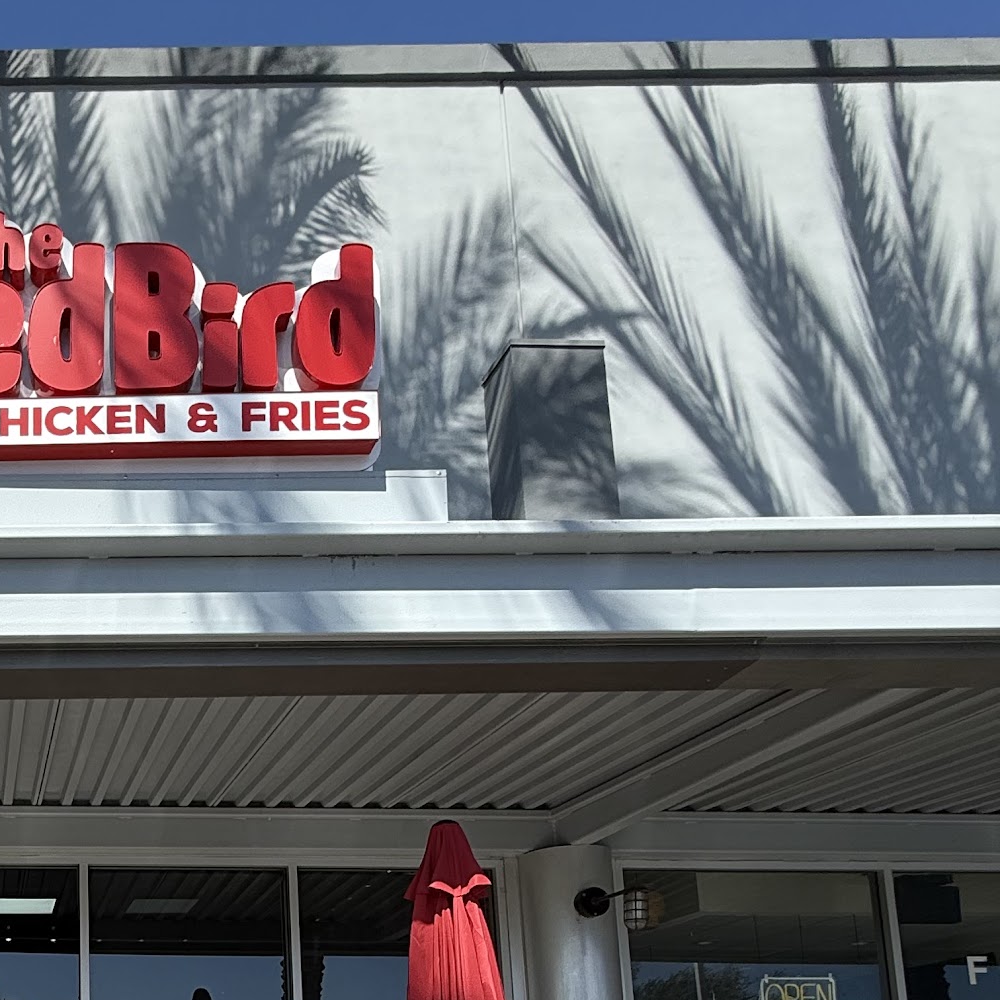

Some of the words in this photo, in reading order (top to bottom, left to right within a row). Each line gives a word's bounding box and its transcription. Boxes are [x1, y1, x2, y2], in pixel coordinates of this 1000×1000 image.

[187, 402, 217, 432] &
[241, 399, 371, 432] FRIES
[966, 955, 988, 985] F
